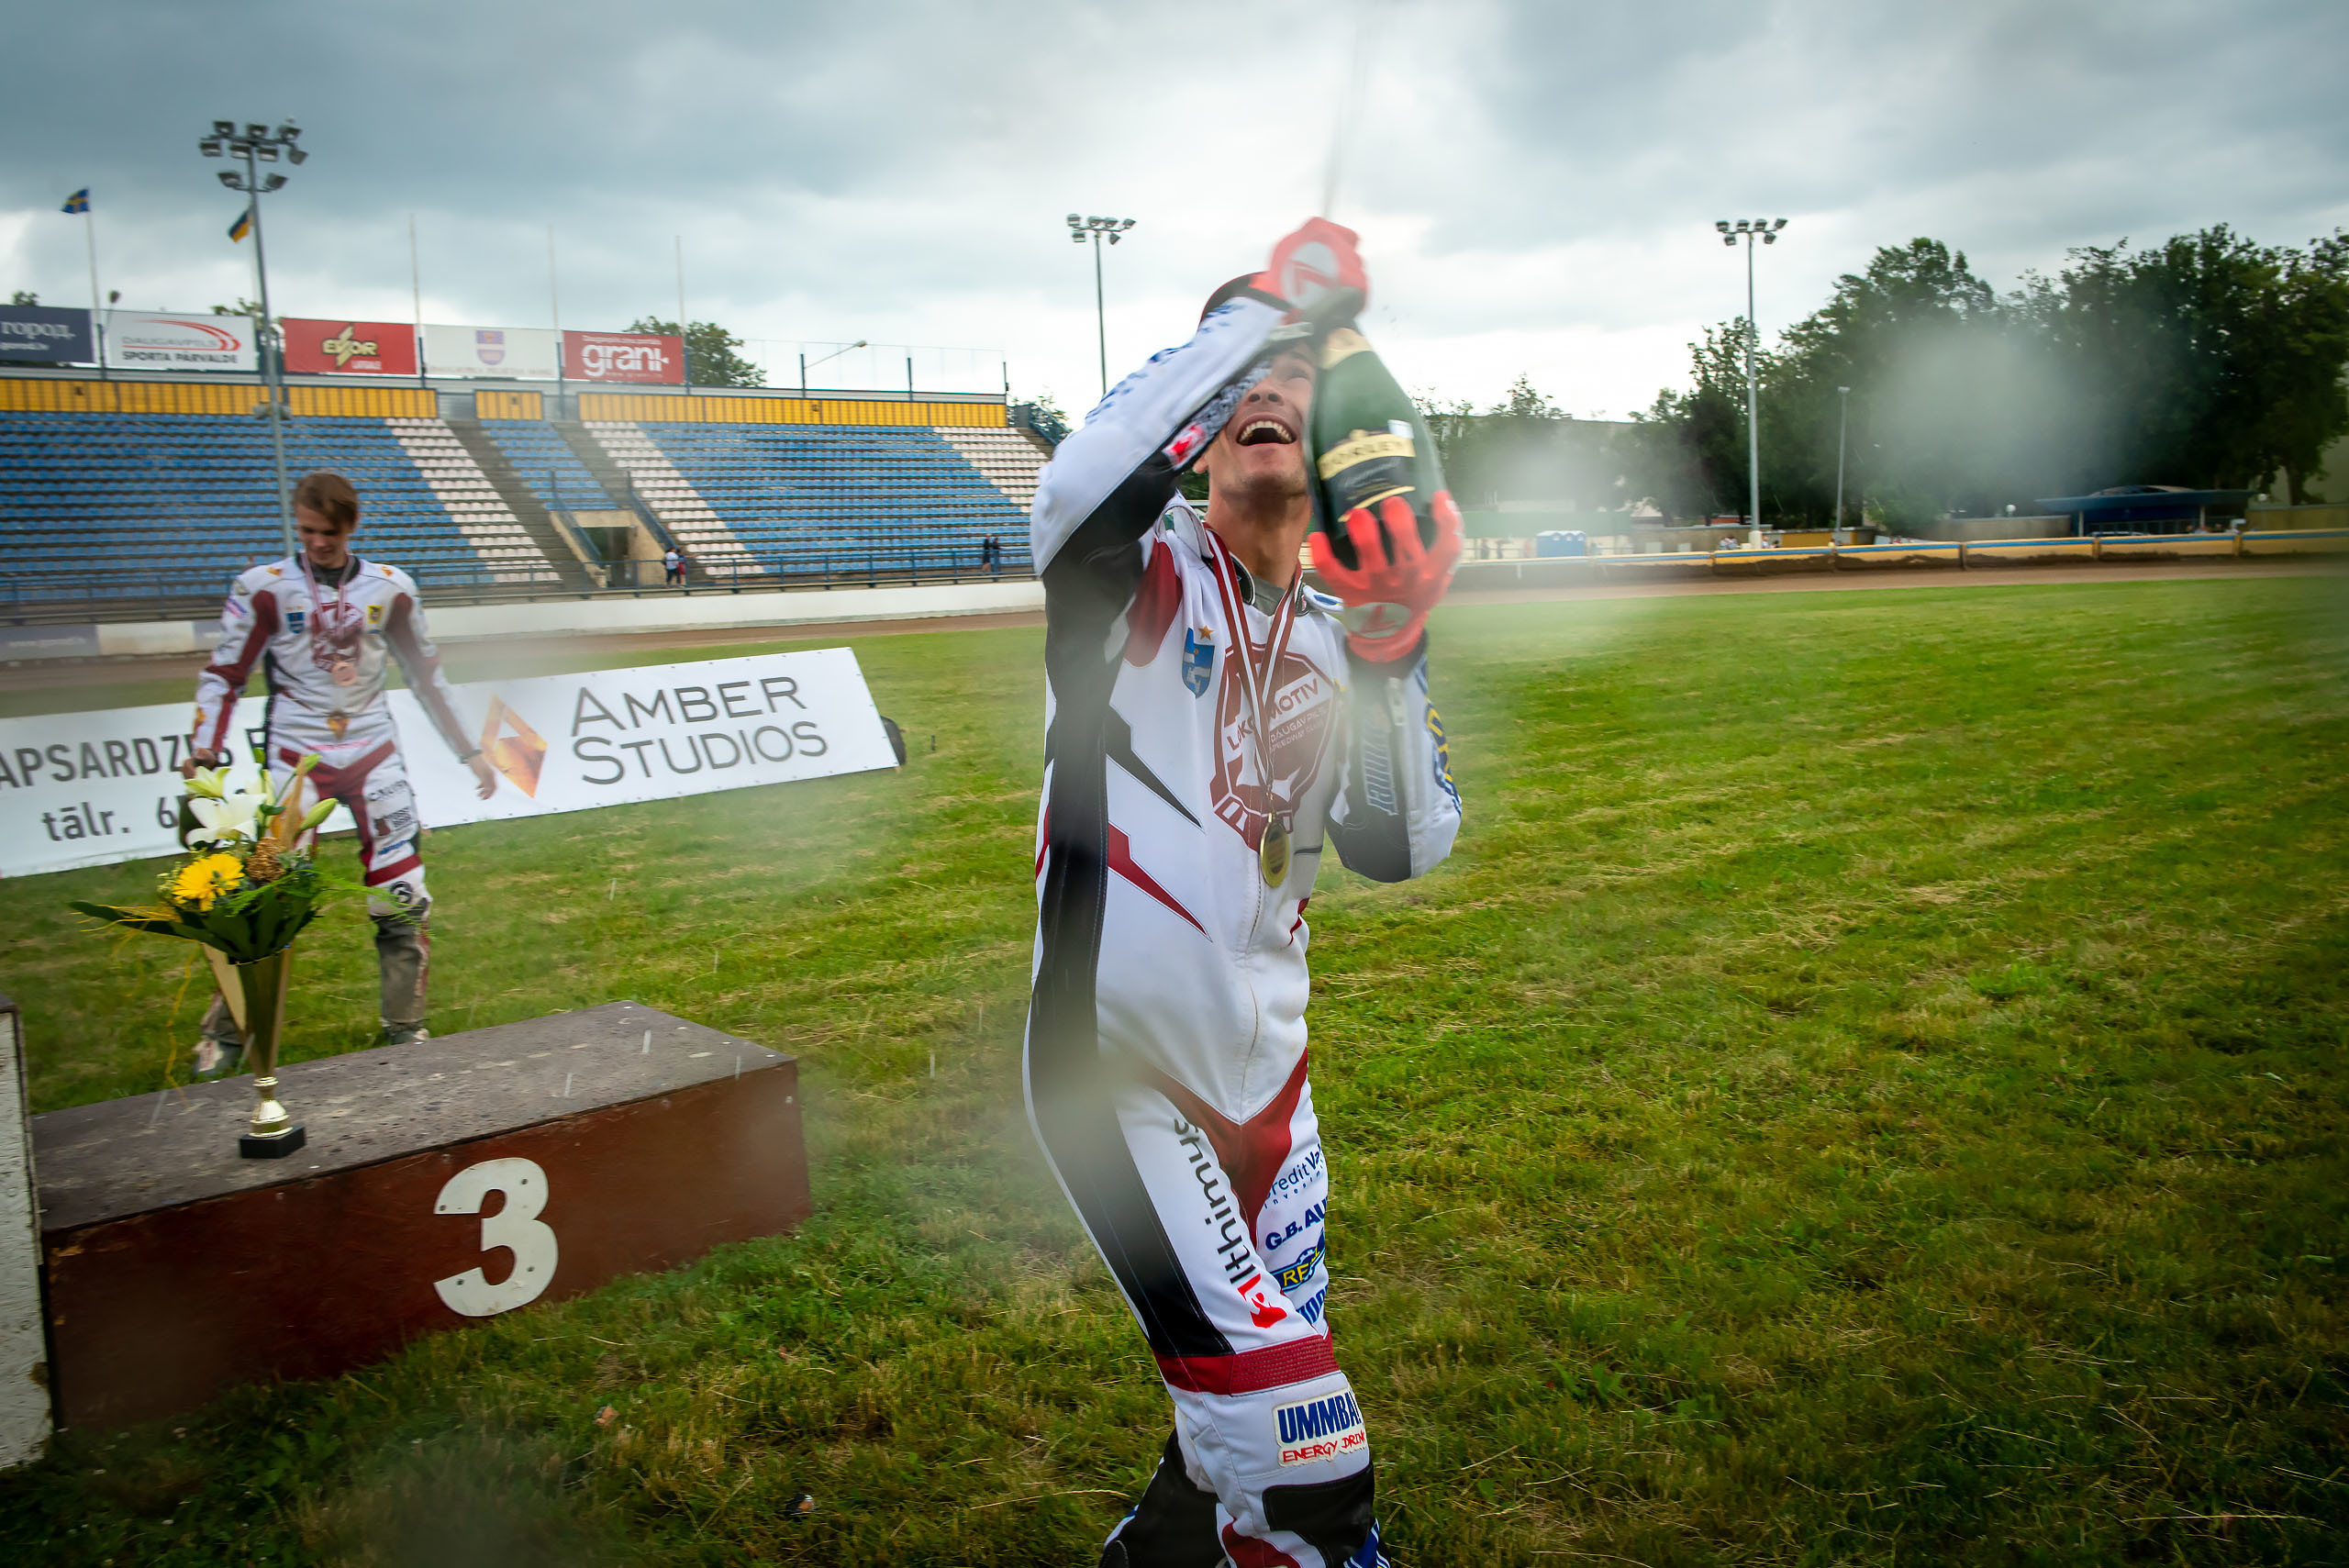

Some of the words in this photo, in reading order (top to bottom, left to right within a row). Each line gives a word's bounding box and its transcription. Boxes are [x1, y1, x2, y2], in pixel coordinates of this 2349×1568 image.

[122, 350, 172, 361] SPORTA
[571, 675, 808, 738] AMBER
[573, 720, 829, 785] STUDIOS
[41, 801, 131, 841] tālr.
[433, 1157, 560, 1318] 3
[1265, 1220, 1304, 1251] G.B.
[1282, 1439, 1339, 1463] ENERGY
[1341, 1429, 1366, 1450] DRIN
